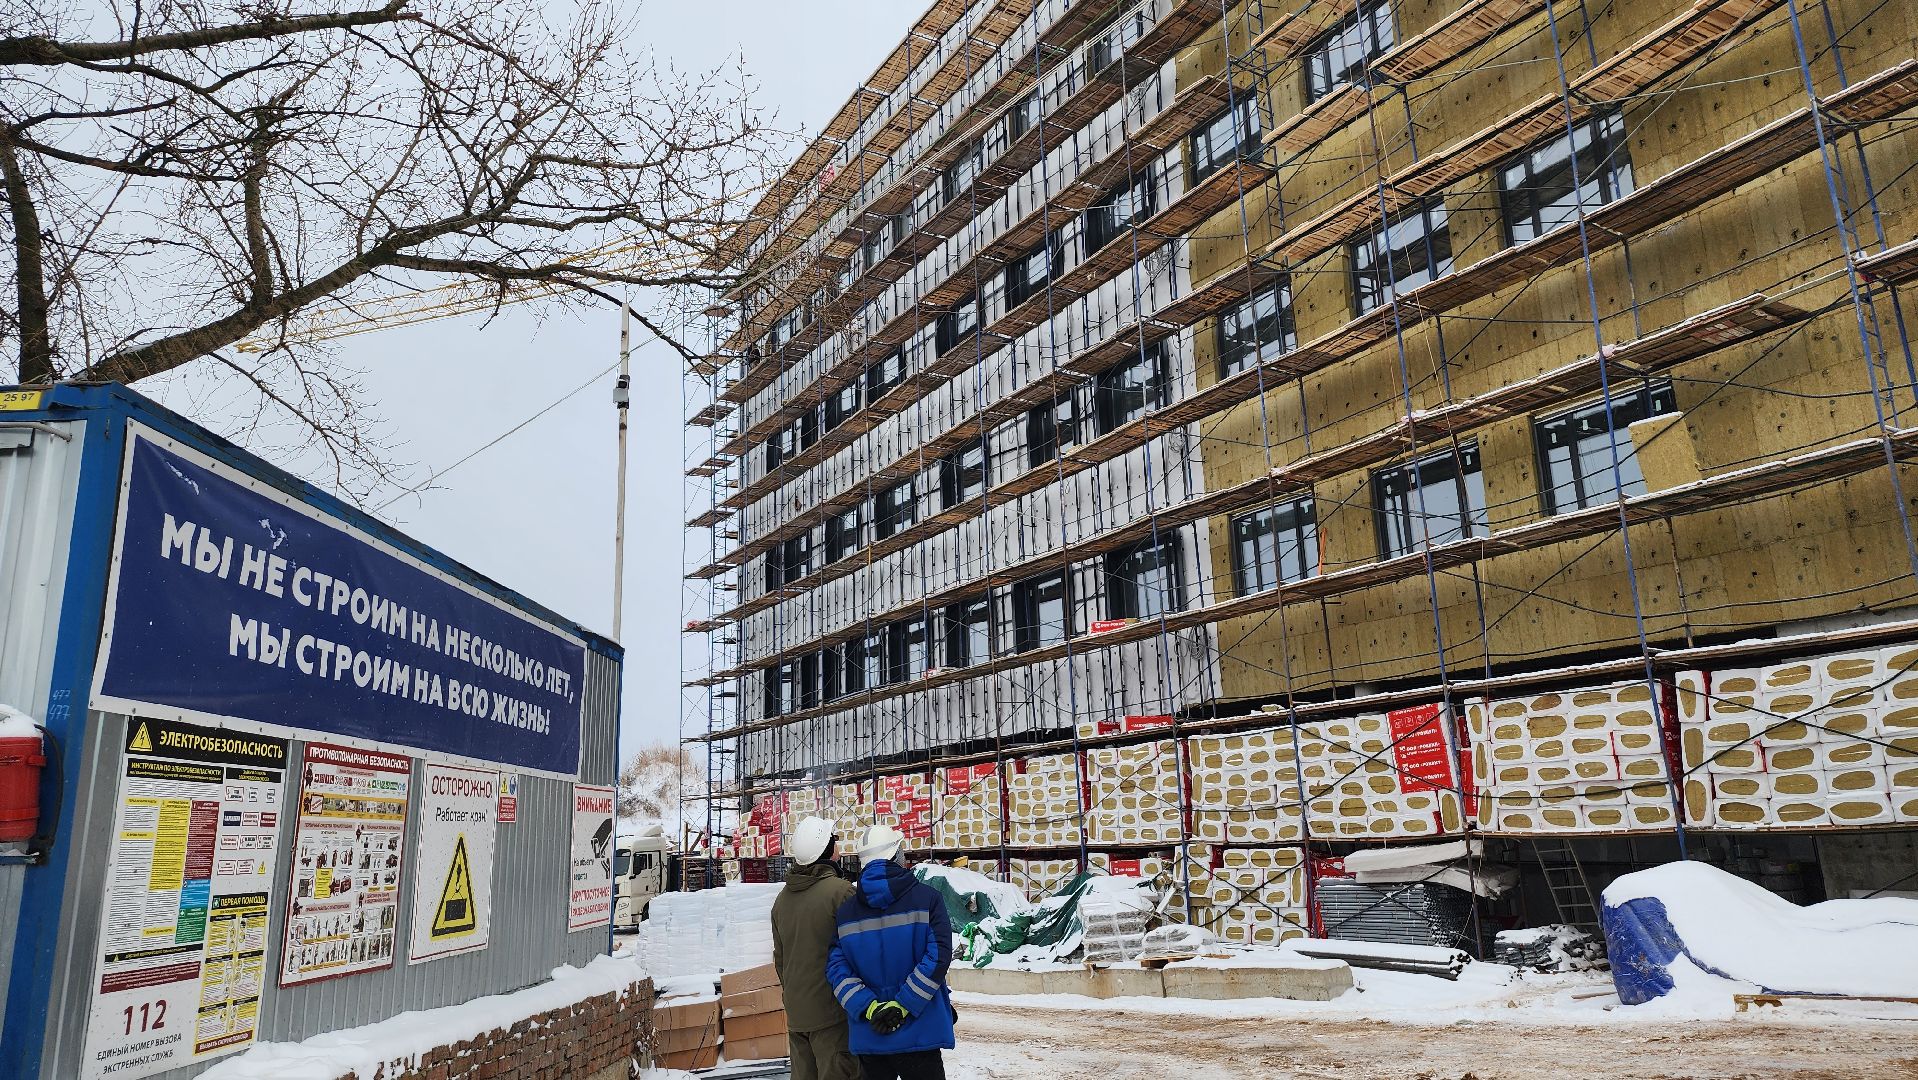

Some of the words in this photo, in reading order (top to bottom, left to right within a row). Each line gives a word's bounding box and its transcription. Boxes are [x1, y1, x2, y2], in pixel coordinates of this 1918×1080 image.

[4, 393, 17, 402] 25
[21, 393, 35, 401] 97
[161, 513, 234, 579] МЫ
[239, 544, 288, 598] НЕ
[292, 567, 407, 640] СТРОИМ
[411, 611, 440, 652] НА
[444, 625, 544, 688] НЕСКОЛЬКО
[546, 666, 574, 704] ЛЕТ,
[229, 613, 291, 668] МЫ
[295, 634, 410, 698] СТРОИМ
[414, 668, 443, 707] НА
[448, 680, 489, 718] ВСЮ
[490, 692, 550, 736] ЖИЗНЬ!
[159, 730, 283, 759] ЭЛЕКТРОБЕЗОПАСНОСТЬ
[309, 746, 369, 764] ПРОТИВОПОЖАРНАЯ
[369, 756, 409, 770] БЕЗОПАСНОСТЬ
[432, 775, 493, 798] ОСТОРОЖНО!
[435, 807, 468, 822] Работает
[576, 796, 613, 813] ВНИМАНИЕ!
[124, 999, 167, 1035] 112
[97, 1043, 129, 1061] ЕДИНЫЙ
[130, 1039, 154, 1054] НОМЕР
[155, 1033, 182, 1047] ВЫЗОВА
[103, 1054, 150, 1074] ЭКСТРЕННЫХ
[151, 1049, 174, 1064] СЛУЖБ
